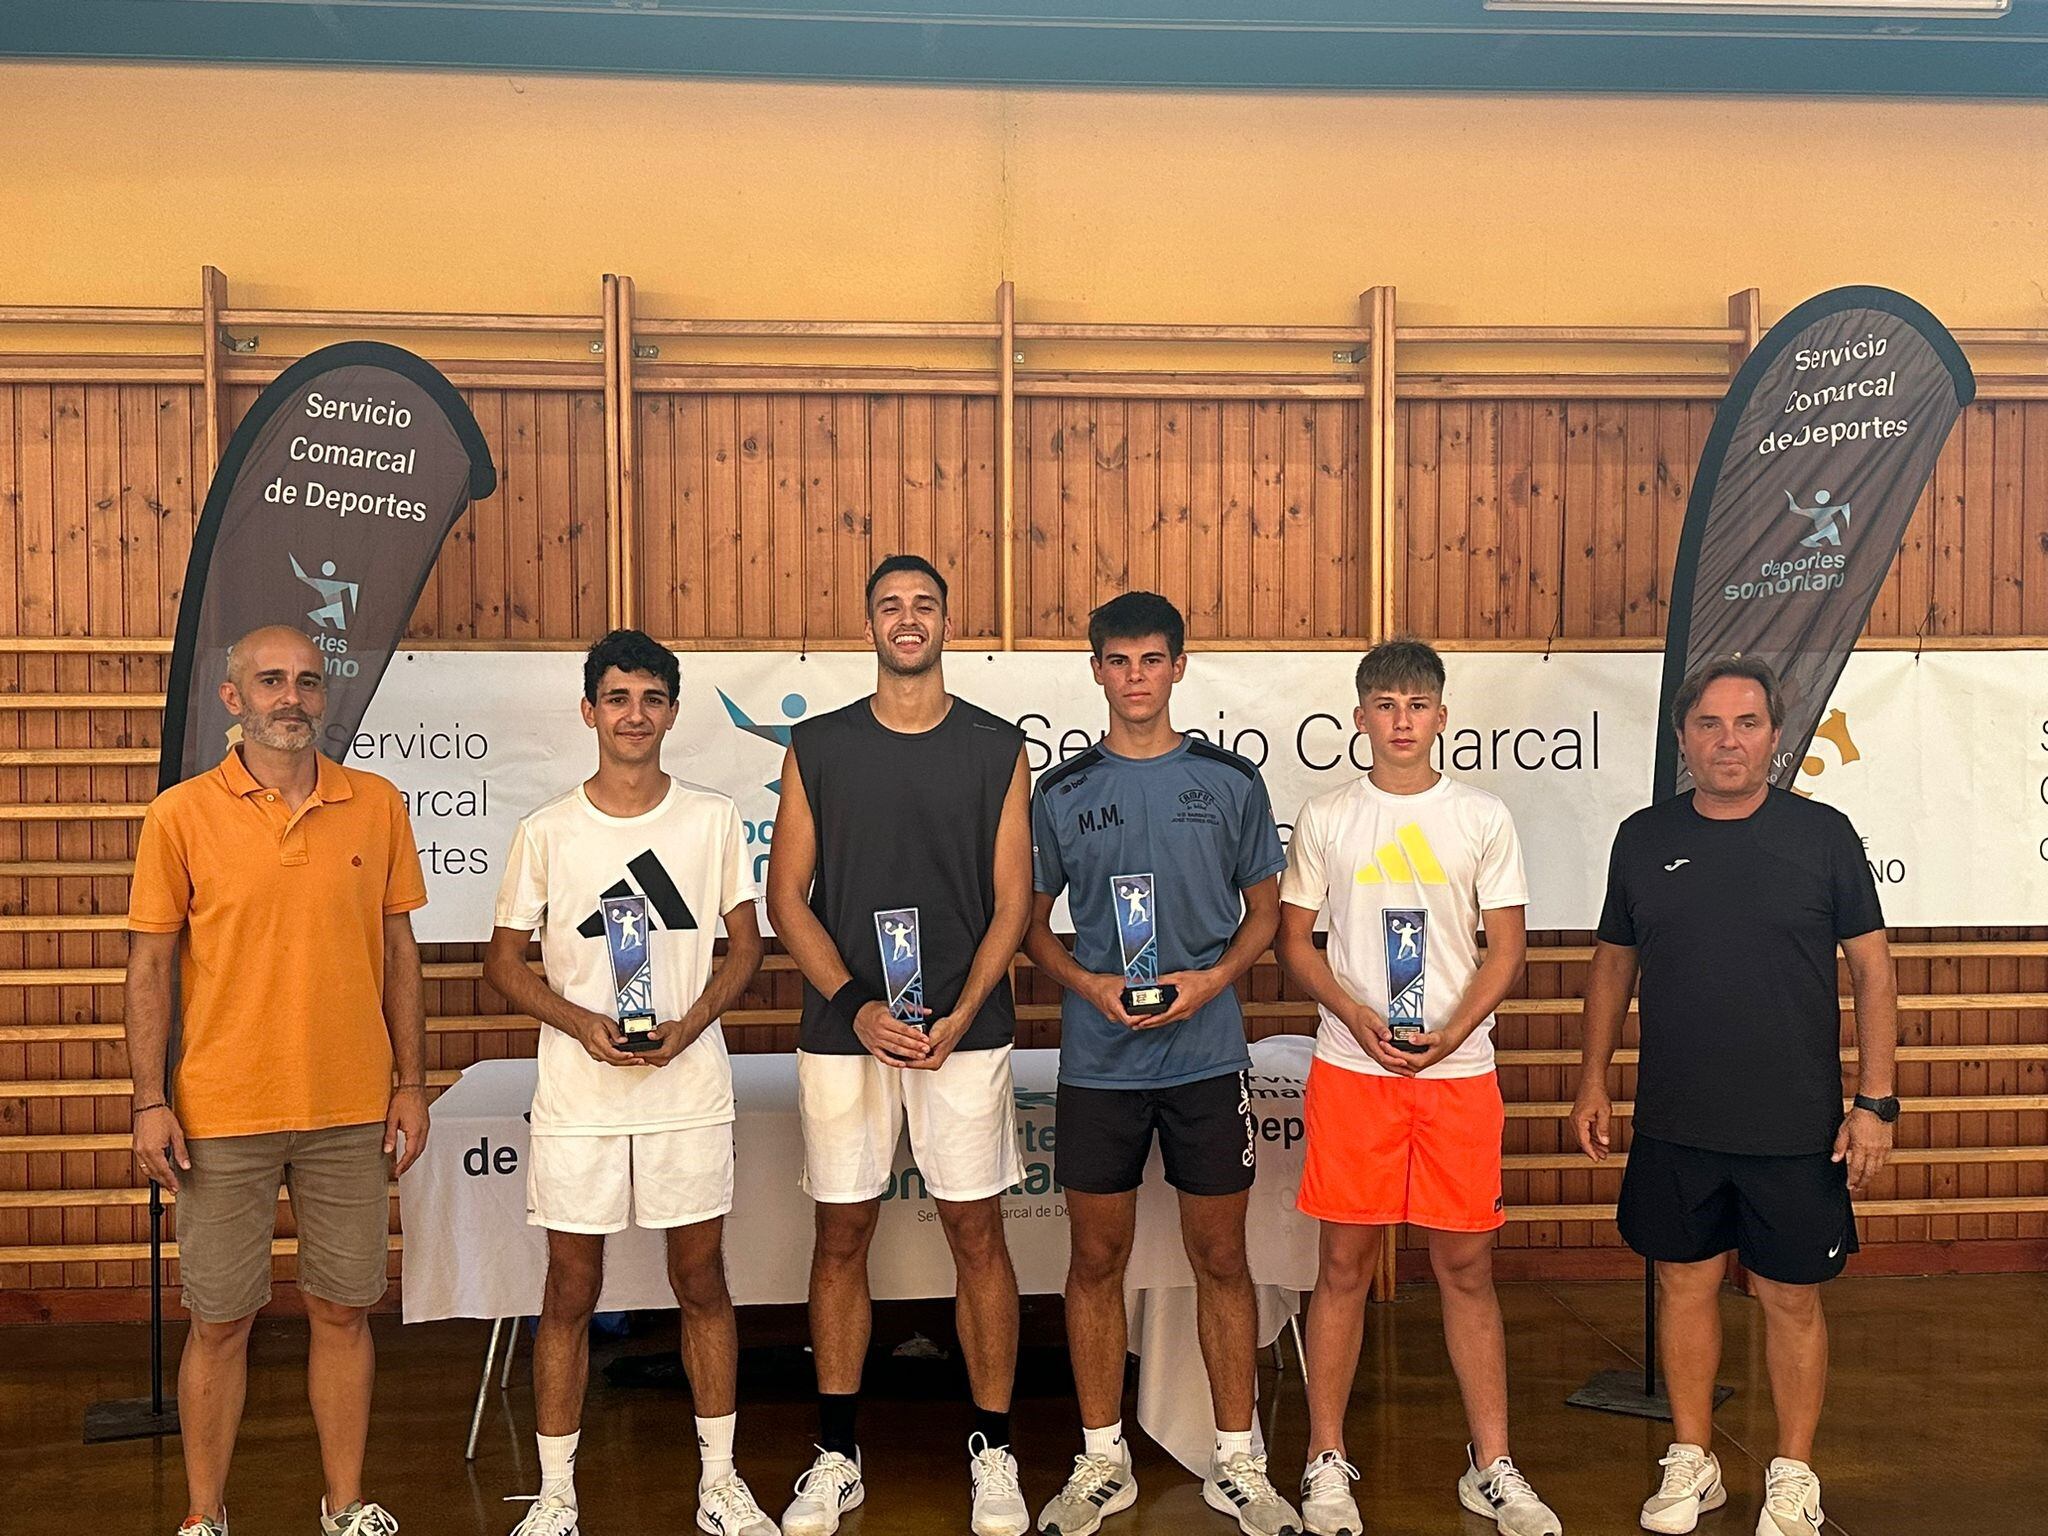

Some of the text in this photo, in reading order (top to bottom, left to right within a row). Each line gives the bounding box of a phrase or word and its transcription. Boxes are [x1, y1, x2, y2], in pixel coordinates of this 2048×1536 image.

[1795, 334, 1887, 371] Servicio
[305, 392, 412, 428] Servicio
[1784, 371, 1896, 414] Comarcal
[290, 436, 416, 474] Comarcal
[1758, 417, 1908, 455] de Deportes
[264, 477, 428, 522] de Deportes
[1761, 552, 1846, 579] deportes
[399, 779, 487, 817] arcal
[1078, 804, 1124, 835] M.M.
[462, 1137, 518, 1176] de
[1036, 1204, 1051, 1217] de
